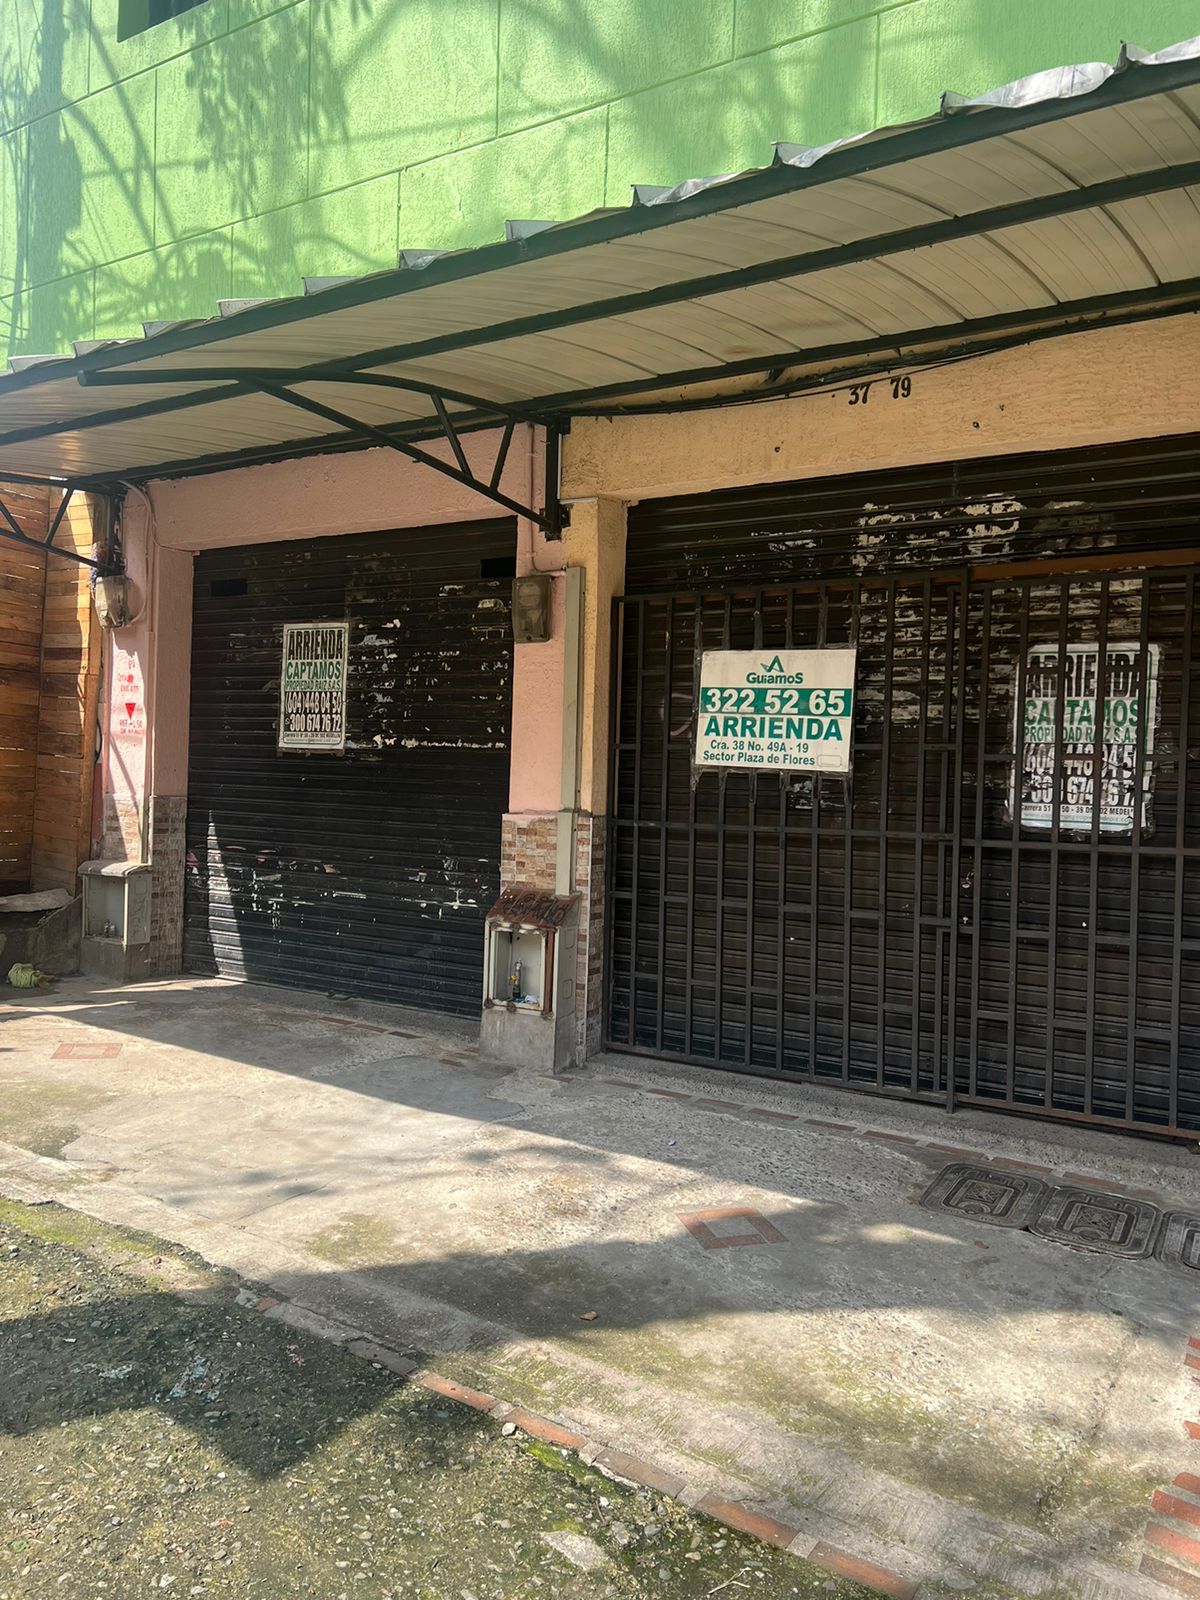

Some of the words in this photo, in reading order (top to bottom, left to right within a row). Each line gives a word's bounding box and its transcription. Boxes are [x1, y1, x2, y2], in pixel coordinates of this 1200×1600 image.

[848, 384, 871, 405] 37
[890, 376, 911, 399] 79
[288, 630, 343, 660] ARRIENDA
[286, 661, 341, 680] CAPTAMOS
[321, 691, 330, 713] 04
[332, 691, 342, 714] 50
[706, 688, 755, 713] 322
[764, 690, 799, 714] 52
[808, 690, 845, 716] 65
[290, 714, 305, 732] 300
[307, 714, 320, 732] 674
[322, 714, 331, 732] 76
[332, 714, 341, 732] 72
[704, 715, 842, 741] ARRIENDA
[703, 751, 735, 761] Sector
[738, 752, 764, 763] Plaza
[767, 754, 779, 764] de
[783, 755, 815, 765] Flores
[710, 740, 729, 750] Cra.
[732, 740, 744, 750] 38
[748, 741, 763, 752] No.
[767, 742, 786, 752] 49A
[796, 743, 809, 753] 19
